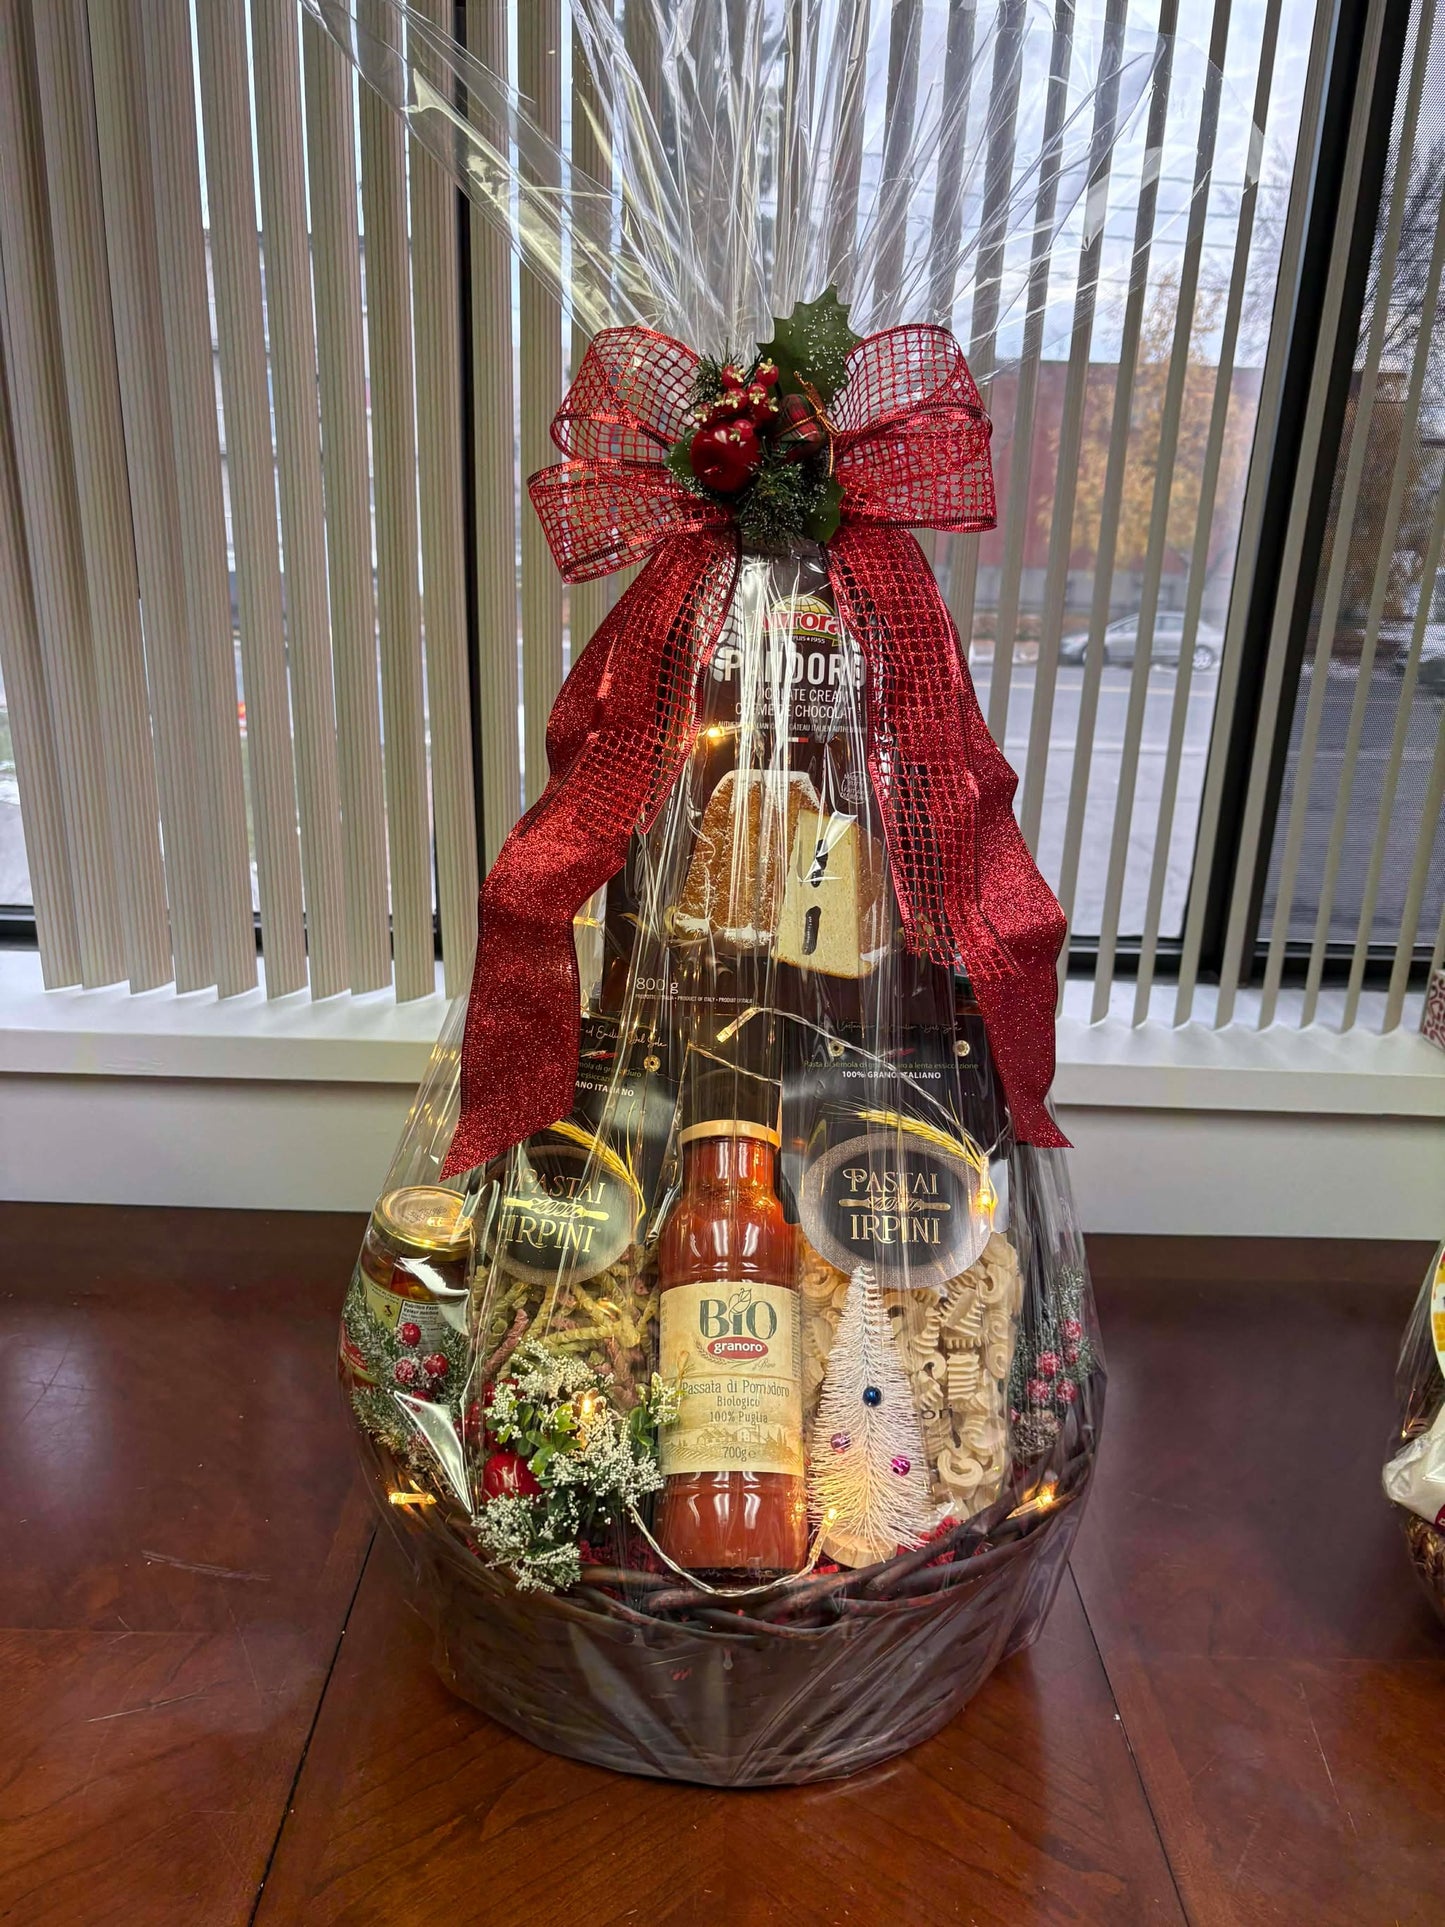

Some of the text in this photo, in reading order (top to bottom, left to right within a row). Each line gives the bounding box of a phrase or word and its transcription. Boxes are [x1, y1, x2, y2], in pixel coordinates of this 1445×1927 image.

[724, 648, 867, 687] PNDORO
[809, 688, 848, 705] CREA
[636, 977, 679, 995] 800 g
[842, 1070, 866, 1079] 100%
[867, 1070, 897, 1079] GRANO
[934, 1062, 979, 1071] essicczione
[575, 1080, 635, 1097] ANO ITAIANO
[842, 1167, 940, 1195] PASTAI
[503, 1214, 596, 1253] IRPINI
[849, 1214, 941, 1245] IRPINI
[713, 1341, 764, 1355] granoro
[681, 1378, 790, 1398] Passata di Pomodoro
[716, 1395, 761, 1410] Biologico
[710, 1410, 768, 1426] 100% Puglia
[722, 1446, 747, 1463] 700g
